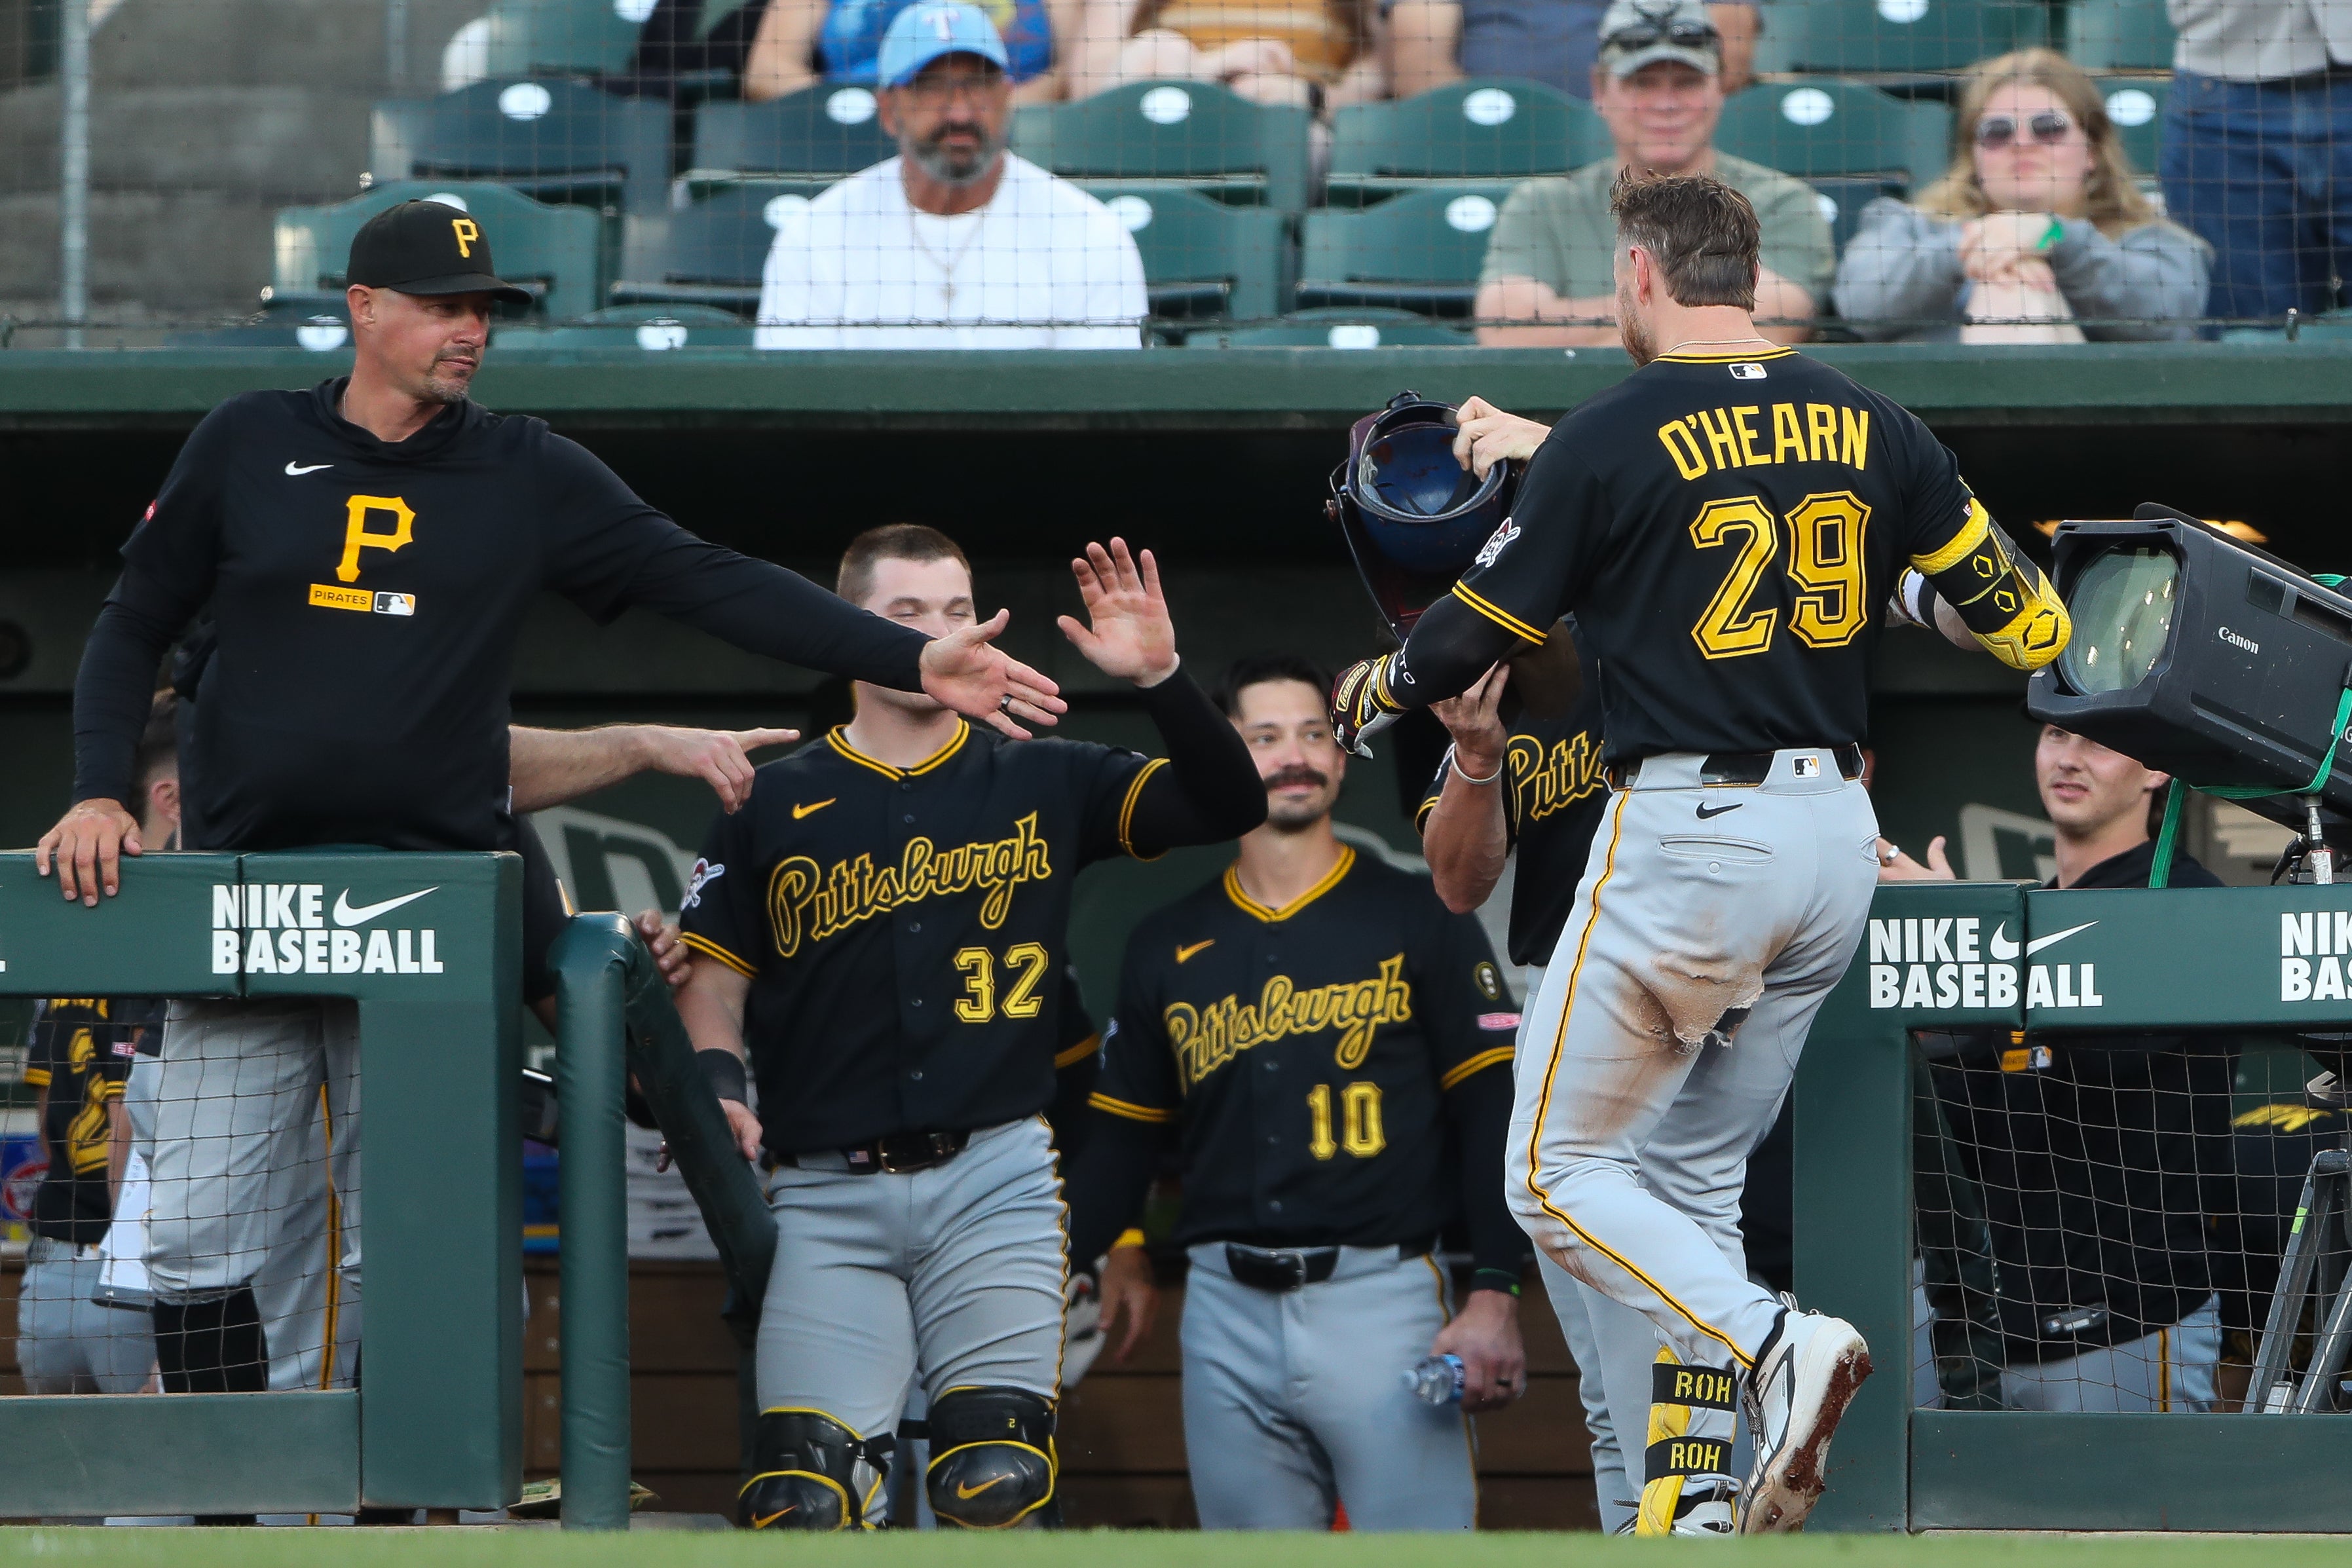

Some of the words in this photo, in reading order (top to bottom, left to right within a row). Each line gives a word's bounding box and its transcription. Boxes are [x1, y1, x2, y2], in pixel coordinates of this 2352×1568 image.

[451, 218, 479, 258] P
[1658, 403, 1869, 481] O'HEARN
[336, 495, 416, 583] P
[314, 590, 368, 605] PIRATES
[1689, 491, 1872, 660] 29
[2218, 626, 2259, 654] Canon
[212, 884, 324, 928] NIKE
[768, 810, 1052, 957] Pittsburgh
[212, 929, 444, 975] BASEBALL
[1869, 918, 1980, 962] NIKE
[953, 942, 1049, 1023] 32
[1870, 963, 2103, 1009] BASEBALL
[1163, 952, 1412, 1098] Pittsburgh
[1307, 1081, 1387, 1161] 10
[1675, 1371, 1732, 1403] ROH
[1670, 1442, 1721, 1471] ROH
